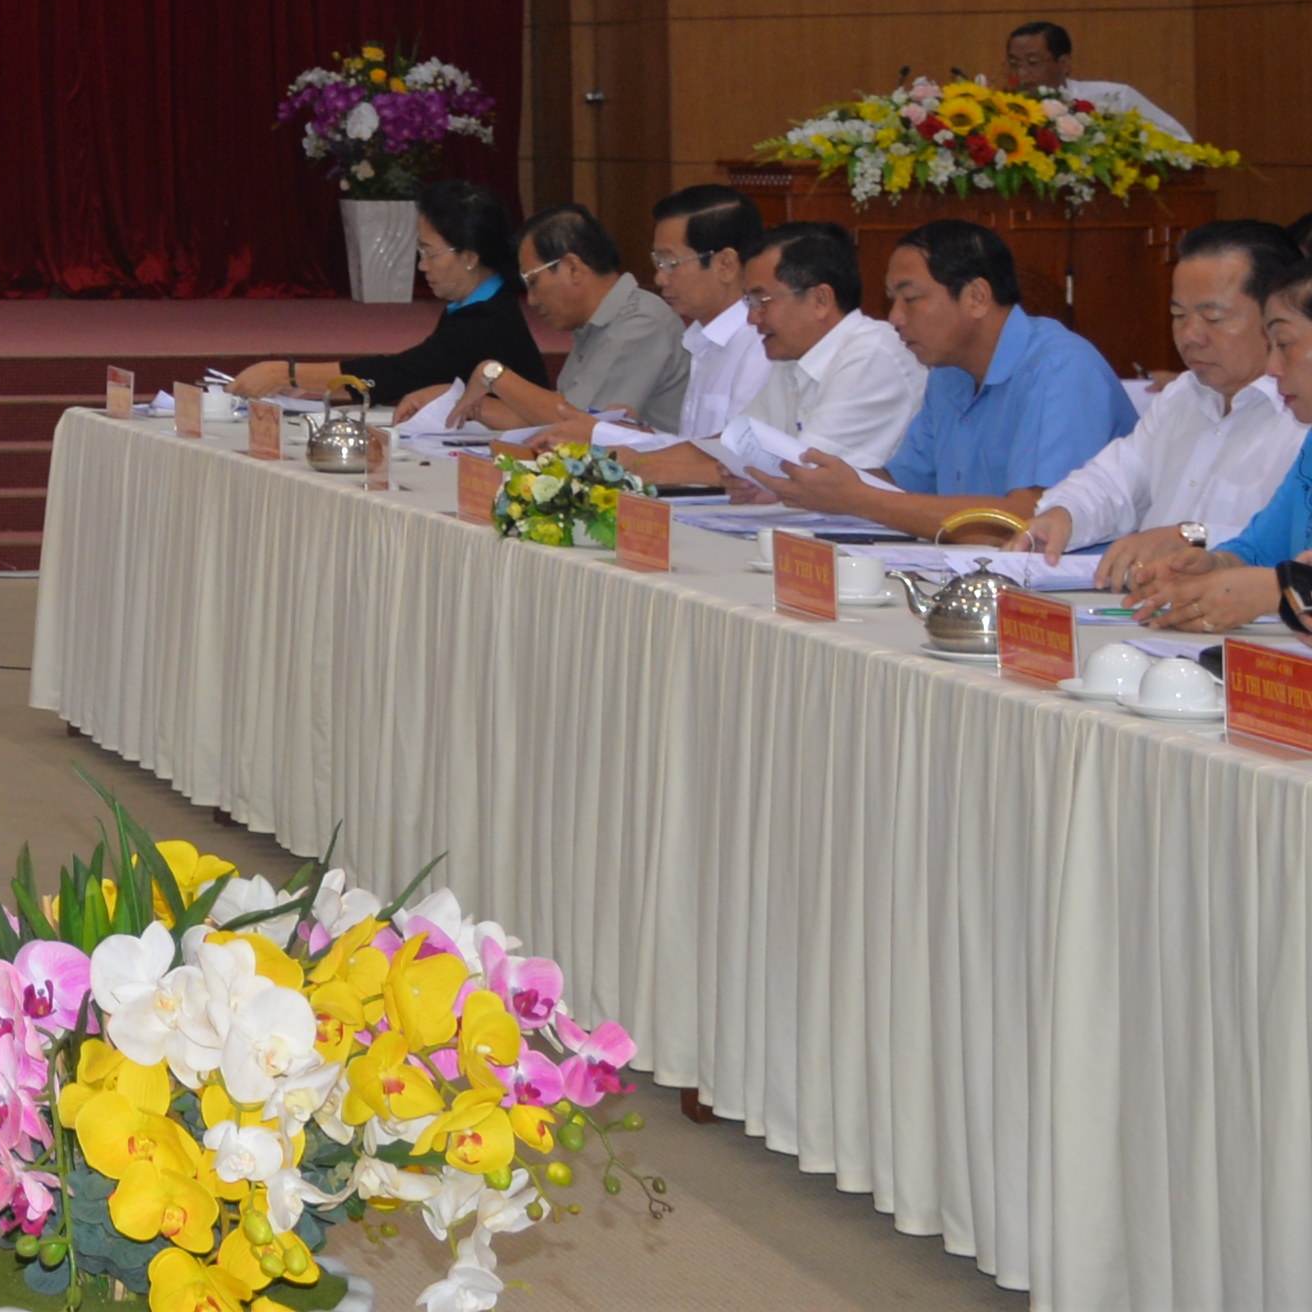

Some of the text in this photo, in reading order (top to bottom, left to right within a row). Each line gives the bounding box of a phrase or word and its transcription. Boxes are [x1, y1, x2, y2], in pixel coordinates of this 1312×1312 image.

[1231, 667, 1243, 692] LÊ
[1244, 674, 1261, 700] THỊ
[1262, 679, 1286, 703] MINH
